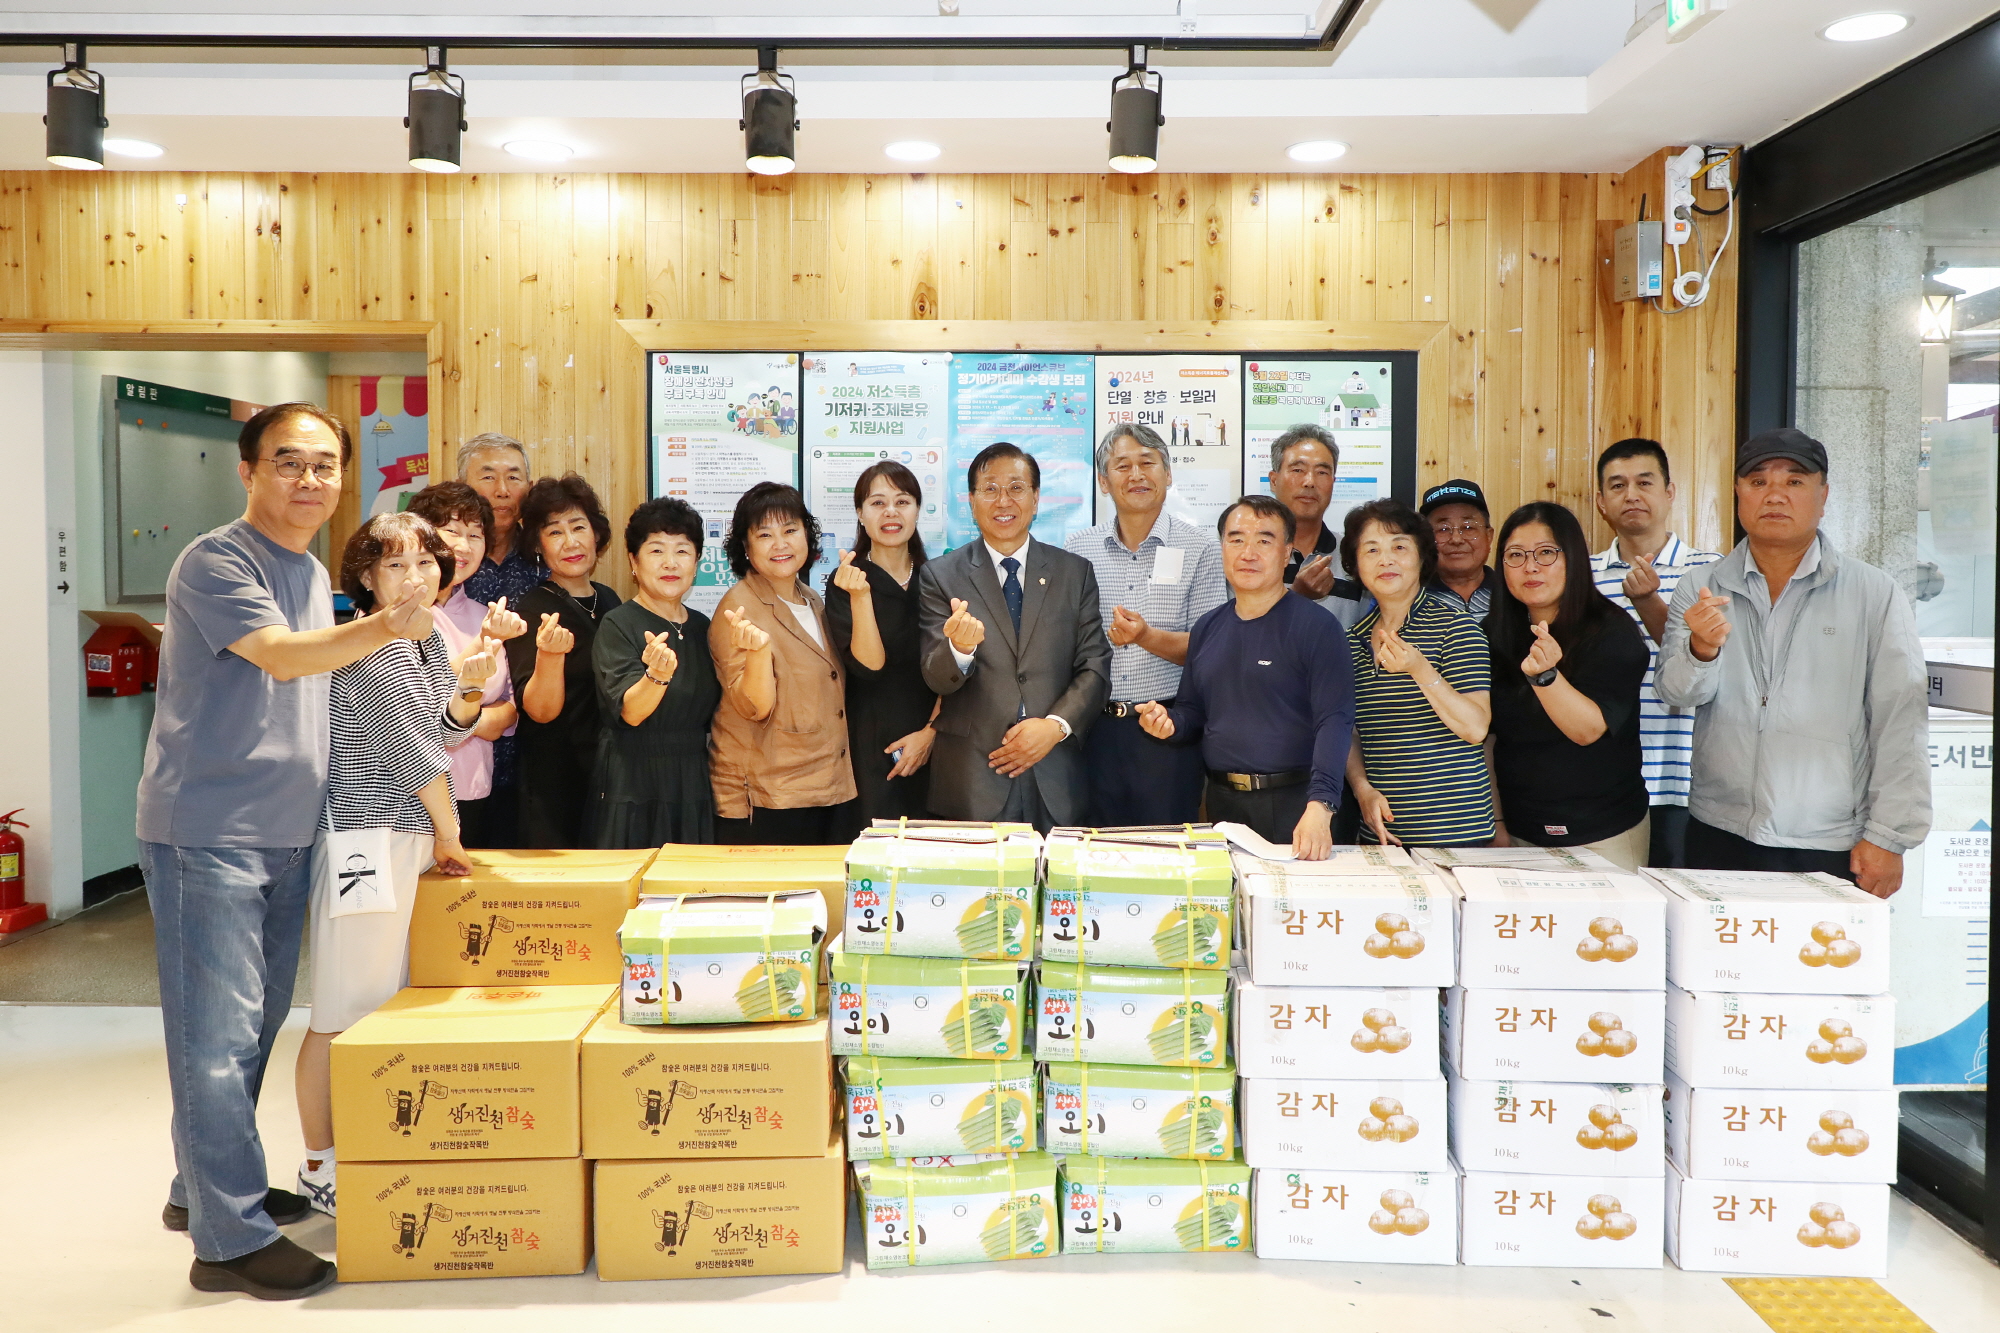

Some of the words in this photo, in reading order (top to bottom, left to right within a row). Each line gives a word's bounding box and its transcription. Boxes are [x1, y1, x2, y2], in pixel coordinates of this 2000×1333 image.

[664, 365, 709, 375] 서울특별시
[978, 363, 997, 371] 2024
[958, 373, 1024, 385] 정기아카데미
[1026, 374, 1060, 386] 수강생
[1063, 374, 1086, 386] 모집
[1108, 371, 1154, 383] 2024년
[1253, 371, 1267, 380] 5월
[664, 377, 693, 388] 장애인
[694, 377, 734, 388] 전자신문
[1253, 383, 1286, 392] 전입신고
[664, 389, 684, 400] 무료
[685, 389, 705, 400] 구독
[706, 389, 726, 400] 안내
[832, 386, 864, 398] 2024
[866, 385, 922, 398] 저소득층
[1108, 390, 1132, 404] 단열
[1144, 390, 1168, 404] 창호
[1180, 390, 1216, 404] 보일러
[824, 402, 929, 417] 기저귀·조제분유
[1108, 410, 1134, 424] 지원
[1138, 410, 1164, 425] 안내
[850, 421, 904, 434] 지원사업
[406, 457, 429, 474] 독산
[118, 648, 140, 656] POST
[1950, 838, 1971, 846] 도서관
[1975, 838, 1989, 846] 운영
[1944, 849, 1979, 857] 도서관으로
[338, 854, 377, 902] CK
[446, 900, 461, 914] 100%
[460, 889, 478, 904] 국내산
[482, 901, 499, 909] 참숯은
[500, 901, 524, 909] 여러분의
[526, 901, 544, 909] 건강을
[545, 900, 582, 908] 지켜드립니다.
[856, 893, 876, 905] 싱싱
[1052, 902, 1072, 914] 싱싱
[856, 908, 904, 933] 오이
[1053, 917, 1100, 941] 오이
[513, 936, 563, 961] 생거진천
[565, 940, 592, 961] 참숯
[631, 965, 651, 978] 싱싱
[1284, 962, 1308, 973] 10kg
[1494, 965, 1520, 975] 10kg
[496, 970, 550, 978] 생거진천참숯작목반
[1715, 970, 1741, 981] 10kg
[634, 980, 682, 1004] 오이
[842, 996, 860, 1009] 싱싱
[1046, 1000, 1066, 1012] 싱싱
[844, 1010, 890, 1035] 오이
[1048, 1015, 1094, 1040] 오이
[371, 1066, 389, 1080] 100%
[386, 1052, 406, 1068] 국내산
[622, 1065, 639, 1078] 100%
[637, 1052, 656, 1068] 국내산
[662, 1064, 680, 1073] 참숯은
[682, 1064, 708, 1072] 여러분의
[710, 1063, 729, 1072] 건강을
[732, 1062, 772, 1072] 지켜드립니다.
[1271, 1056, 1296, 1067] 10kg
[1496, 1058, 1520, 1070] 10kg
[412, 1064, 430, 1074] 참숯은
[432, 1064, 458, 1073] 여러분의
[460, 1063, 480, 1072] 건강을
[482, 1062, 522, 1072] 지켜드립니다.
[1723, 1066, 1748, 1078] 10kg
[855, 1098, 876, 1111] 싱싱
[448, 1102, 503, 1130] 생거진천
[506, 1106, 536, 1130] 참숯
[696, 1102, 752, 1130] 생거진천
[754, 1106, 784, 1130] 참숯
[858, 1114, 904, 1138] 오이
[1058, 1111, 1106, 1134] 오이
[430, 1140, 490, 1150] 생거진천참숯작목반
[678, 1140, 738, 1150] 생거진천참숯작목반
[1278, 1142, 1303, 1154] 10kg
[1494, 1149, 1519, 1160] 10kg
[1724, 1158, 1750, 1170] 10kg
[376, 1188, 394, 1202] 100%
[391, 1174, 411, 1190] 국내산
[416, 1186, 435, 1196] 참숯은
[438, 1186, 464, 1196] 여러분의
[466, 1186, 486, 1194] 건강을
[488, 1184, 528, 1194] 지켜드립니다.
[637, 1186, 655, 1200] 100%
[652, 1172, 672, 1188] 국내산
[678, 1184, 696, 1194] 참숯은
[698, 1184, 724, 1192] 여러분의
[726, 1183, 745, 1192] 건강을
[748, 1181, 788, 1190] 지켜드립니다.
[1075, 1210, 1122, 1234] 오이
[452, 1225, 508, 1252] 생거진천
[510, 1228, 540, 1250] 참숯
[713, 1222, 768, 1249] 생거진천
[770, 1224, 800, 1248] 참숯
[878, 1223, 926, 1248] 오이
[1288, 1234, 1313, 1246] 10kg
[1496, 1242, 1520, 1253] 10kg
[1714, 1248, 1739, 1260] 10kg
[434, 1262, 494, 1271] 생거진천참숯작목반
[694, 1259, 754, 1270] 생거진천참숯작목반
